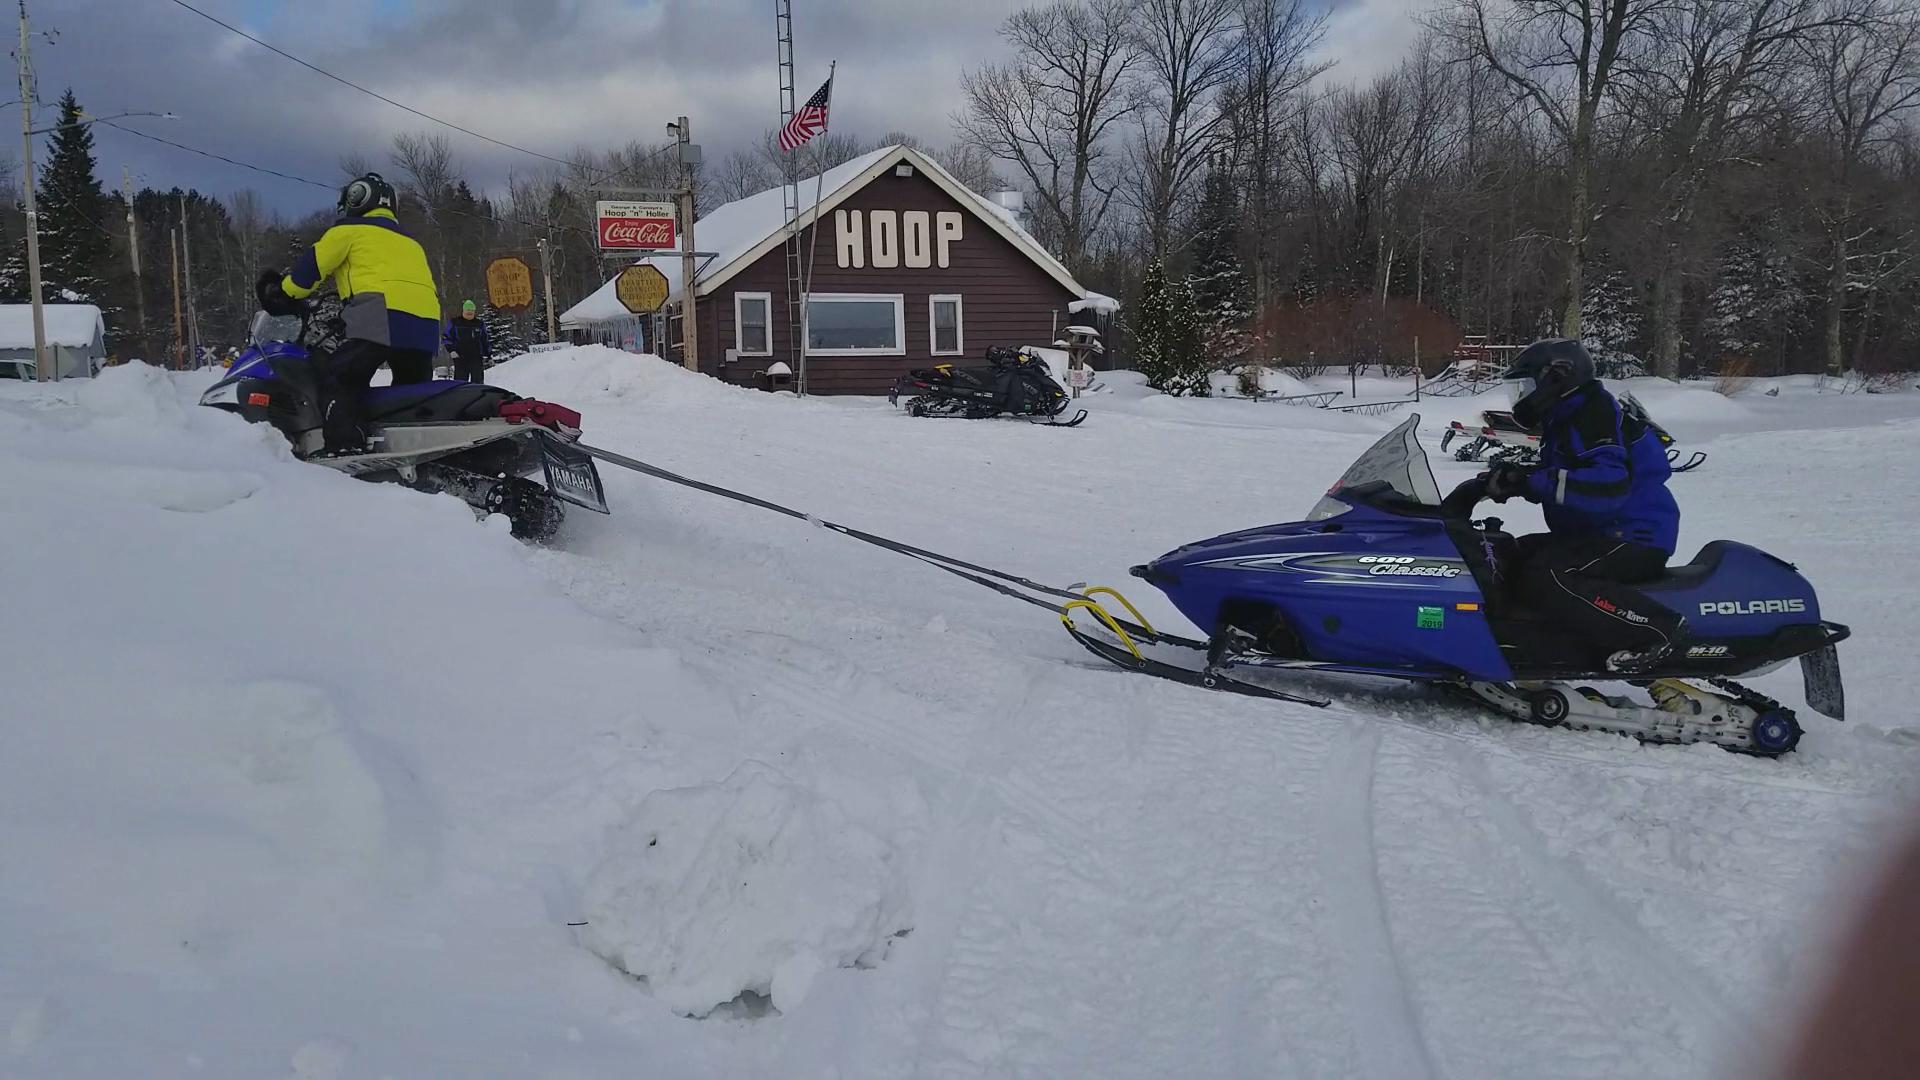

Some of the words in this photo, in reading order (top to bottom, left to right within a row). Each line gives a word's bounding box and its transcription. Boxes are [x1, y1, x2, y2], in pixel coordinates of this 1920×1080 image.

[604, 222, 670, 244] Coca-Cola
[835, 209, 963, 268] HOOP
[548, 463, 594, 493] YAMAHA
[1358, 555, 1416, 564] 600
[1369, 563, 1462, 578] Classic
[1699, 598, 1806, 616] POLARIS
